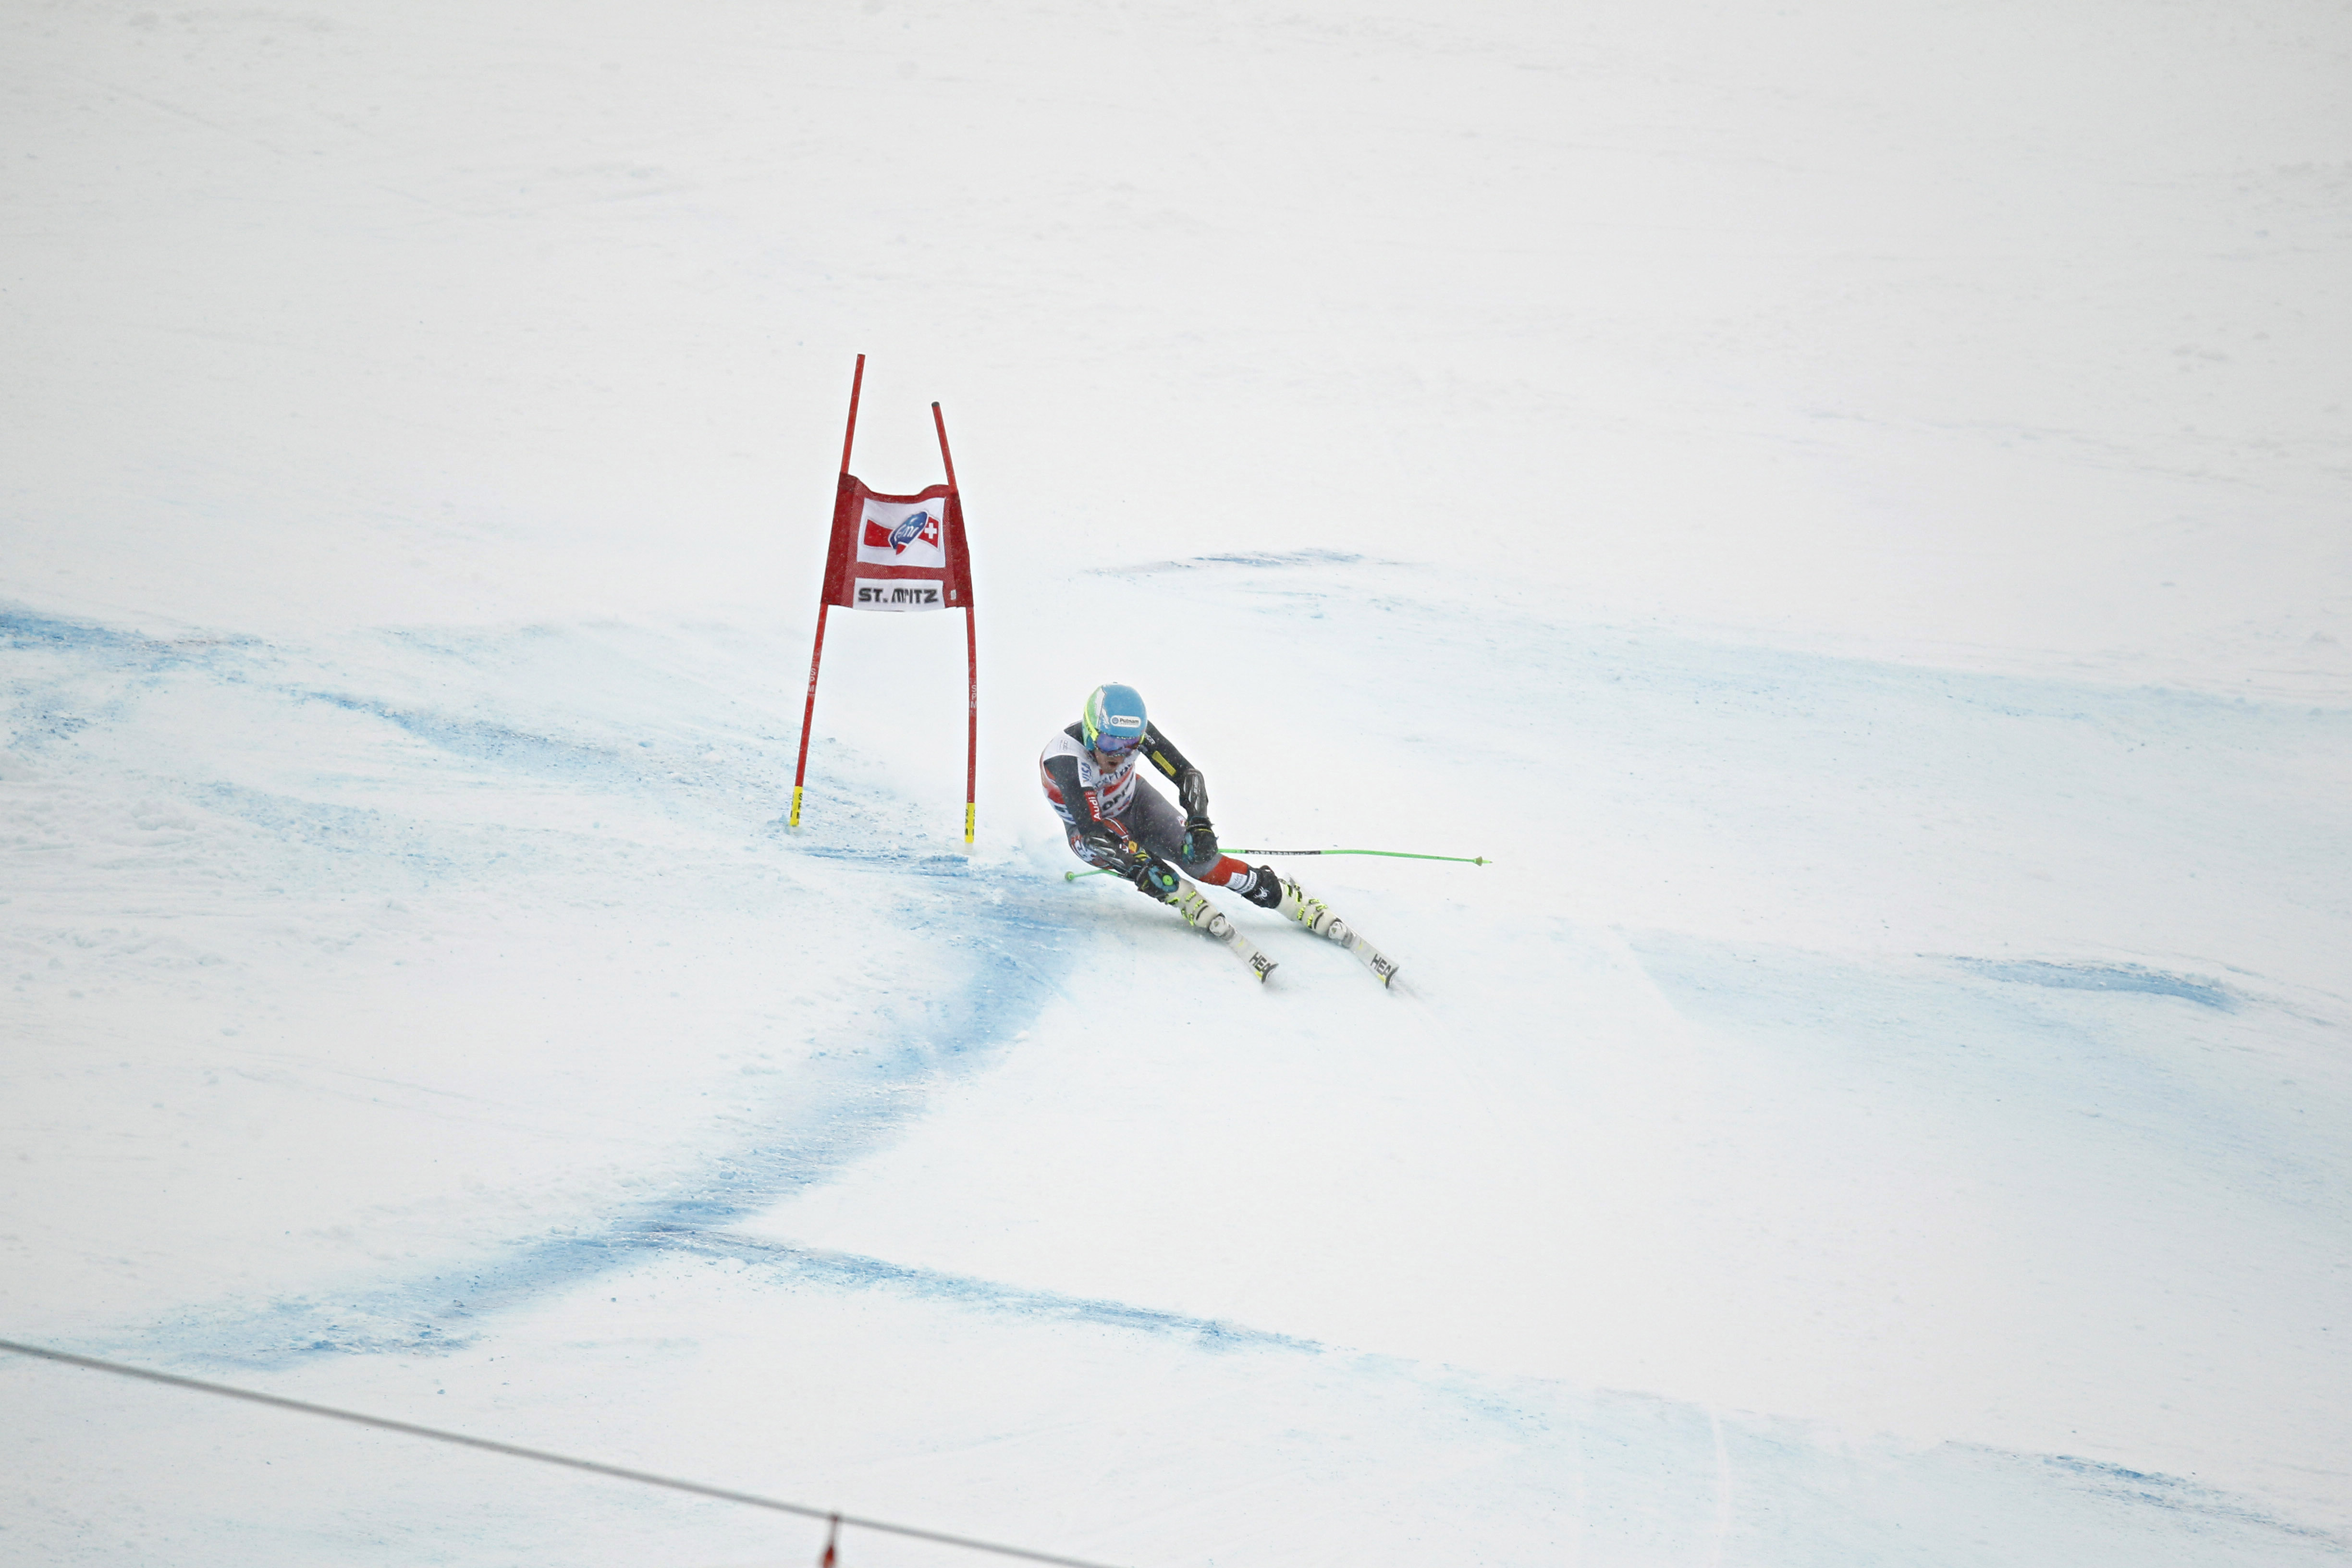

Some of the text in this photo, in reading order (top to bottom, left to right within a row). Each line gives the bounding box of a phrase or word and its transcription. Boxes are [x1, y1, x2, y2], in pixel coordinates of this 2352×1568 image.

[858, 588, 888, 602] ST.
[1088, 796, 1101, 820] Audi
[1249, 952, 1271, 973] HEA
[1370, 953, 1391, 977] HEA
